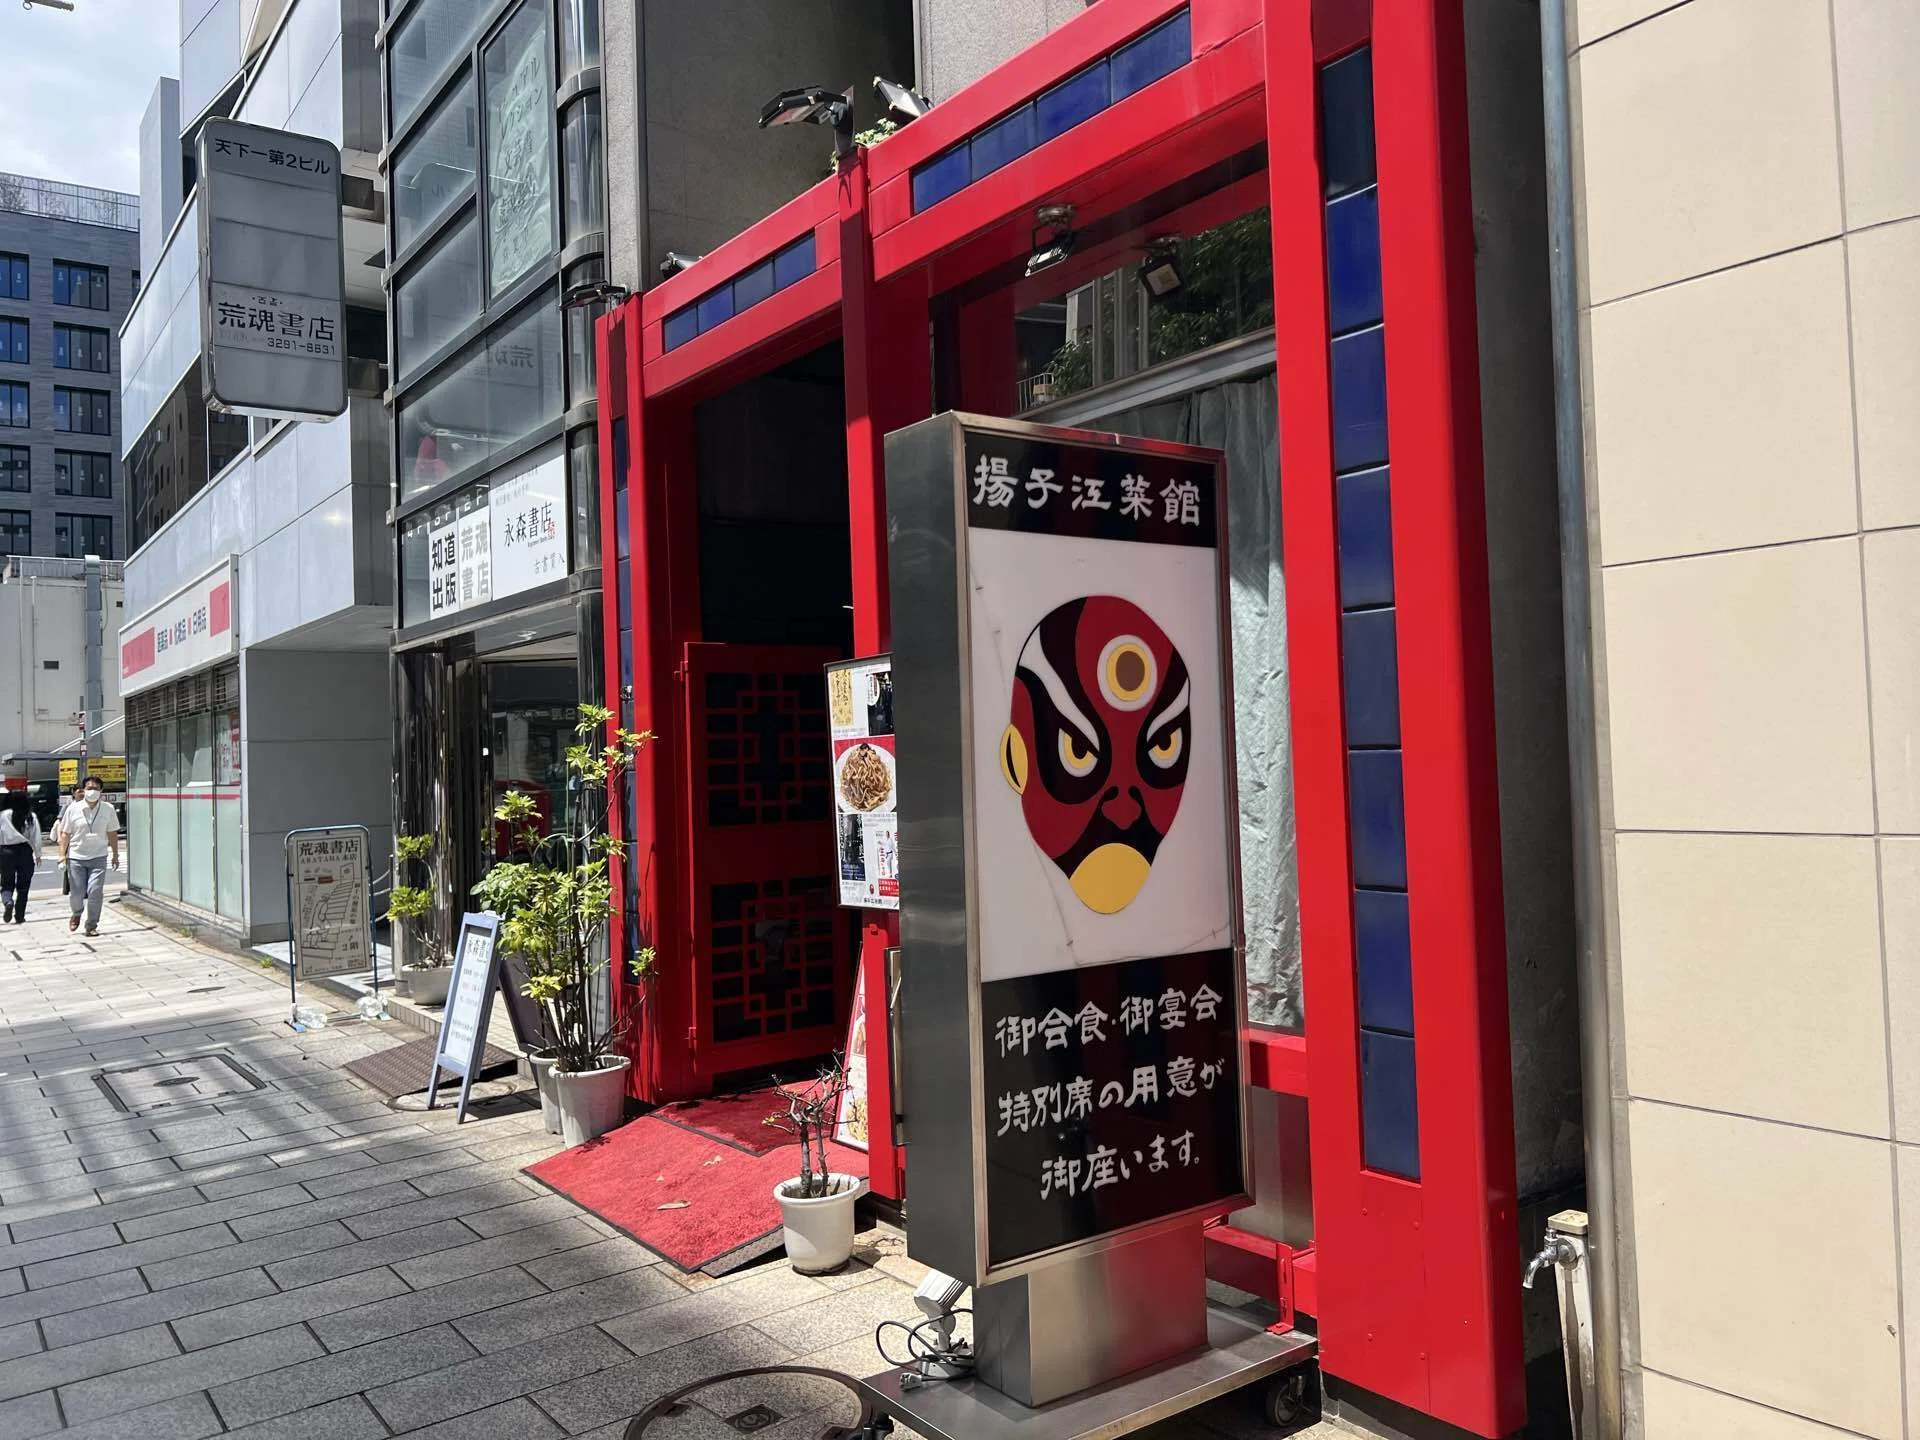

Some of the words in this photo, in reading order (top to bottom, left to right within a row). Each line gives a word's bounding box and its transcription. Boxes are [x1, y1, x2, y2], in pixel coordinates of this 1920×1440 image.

[215, 138, 331, 175] 天下一第2ビル
[218, 302, 334, 341] 荒魂書店
[972, 454, 1201, 527] 揚子江菜館
[504, 501, 553, 547] 永森書店
[432, 532, 455, 571] 知道
[432, 572, 456, 612] 出版
[300, 839, 358, 856] 荒魂書店
[994, 984, 1223, 1058] 御会食・御宴会
[997, 1055, 1225, 1137] 特別席の用意が
[1040, 1129, 1200, 1200] 御座います。
